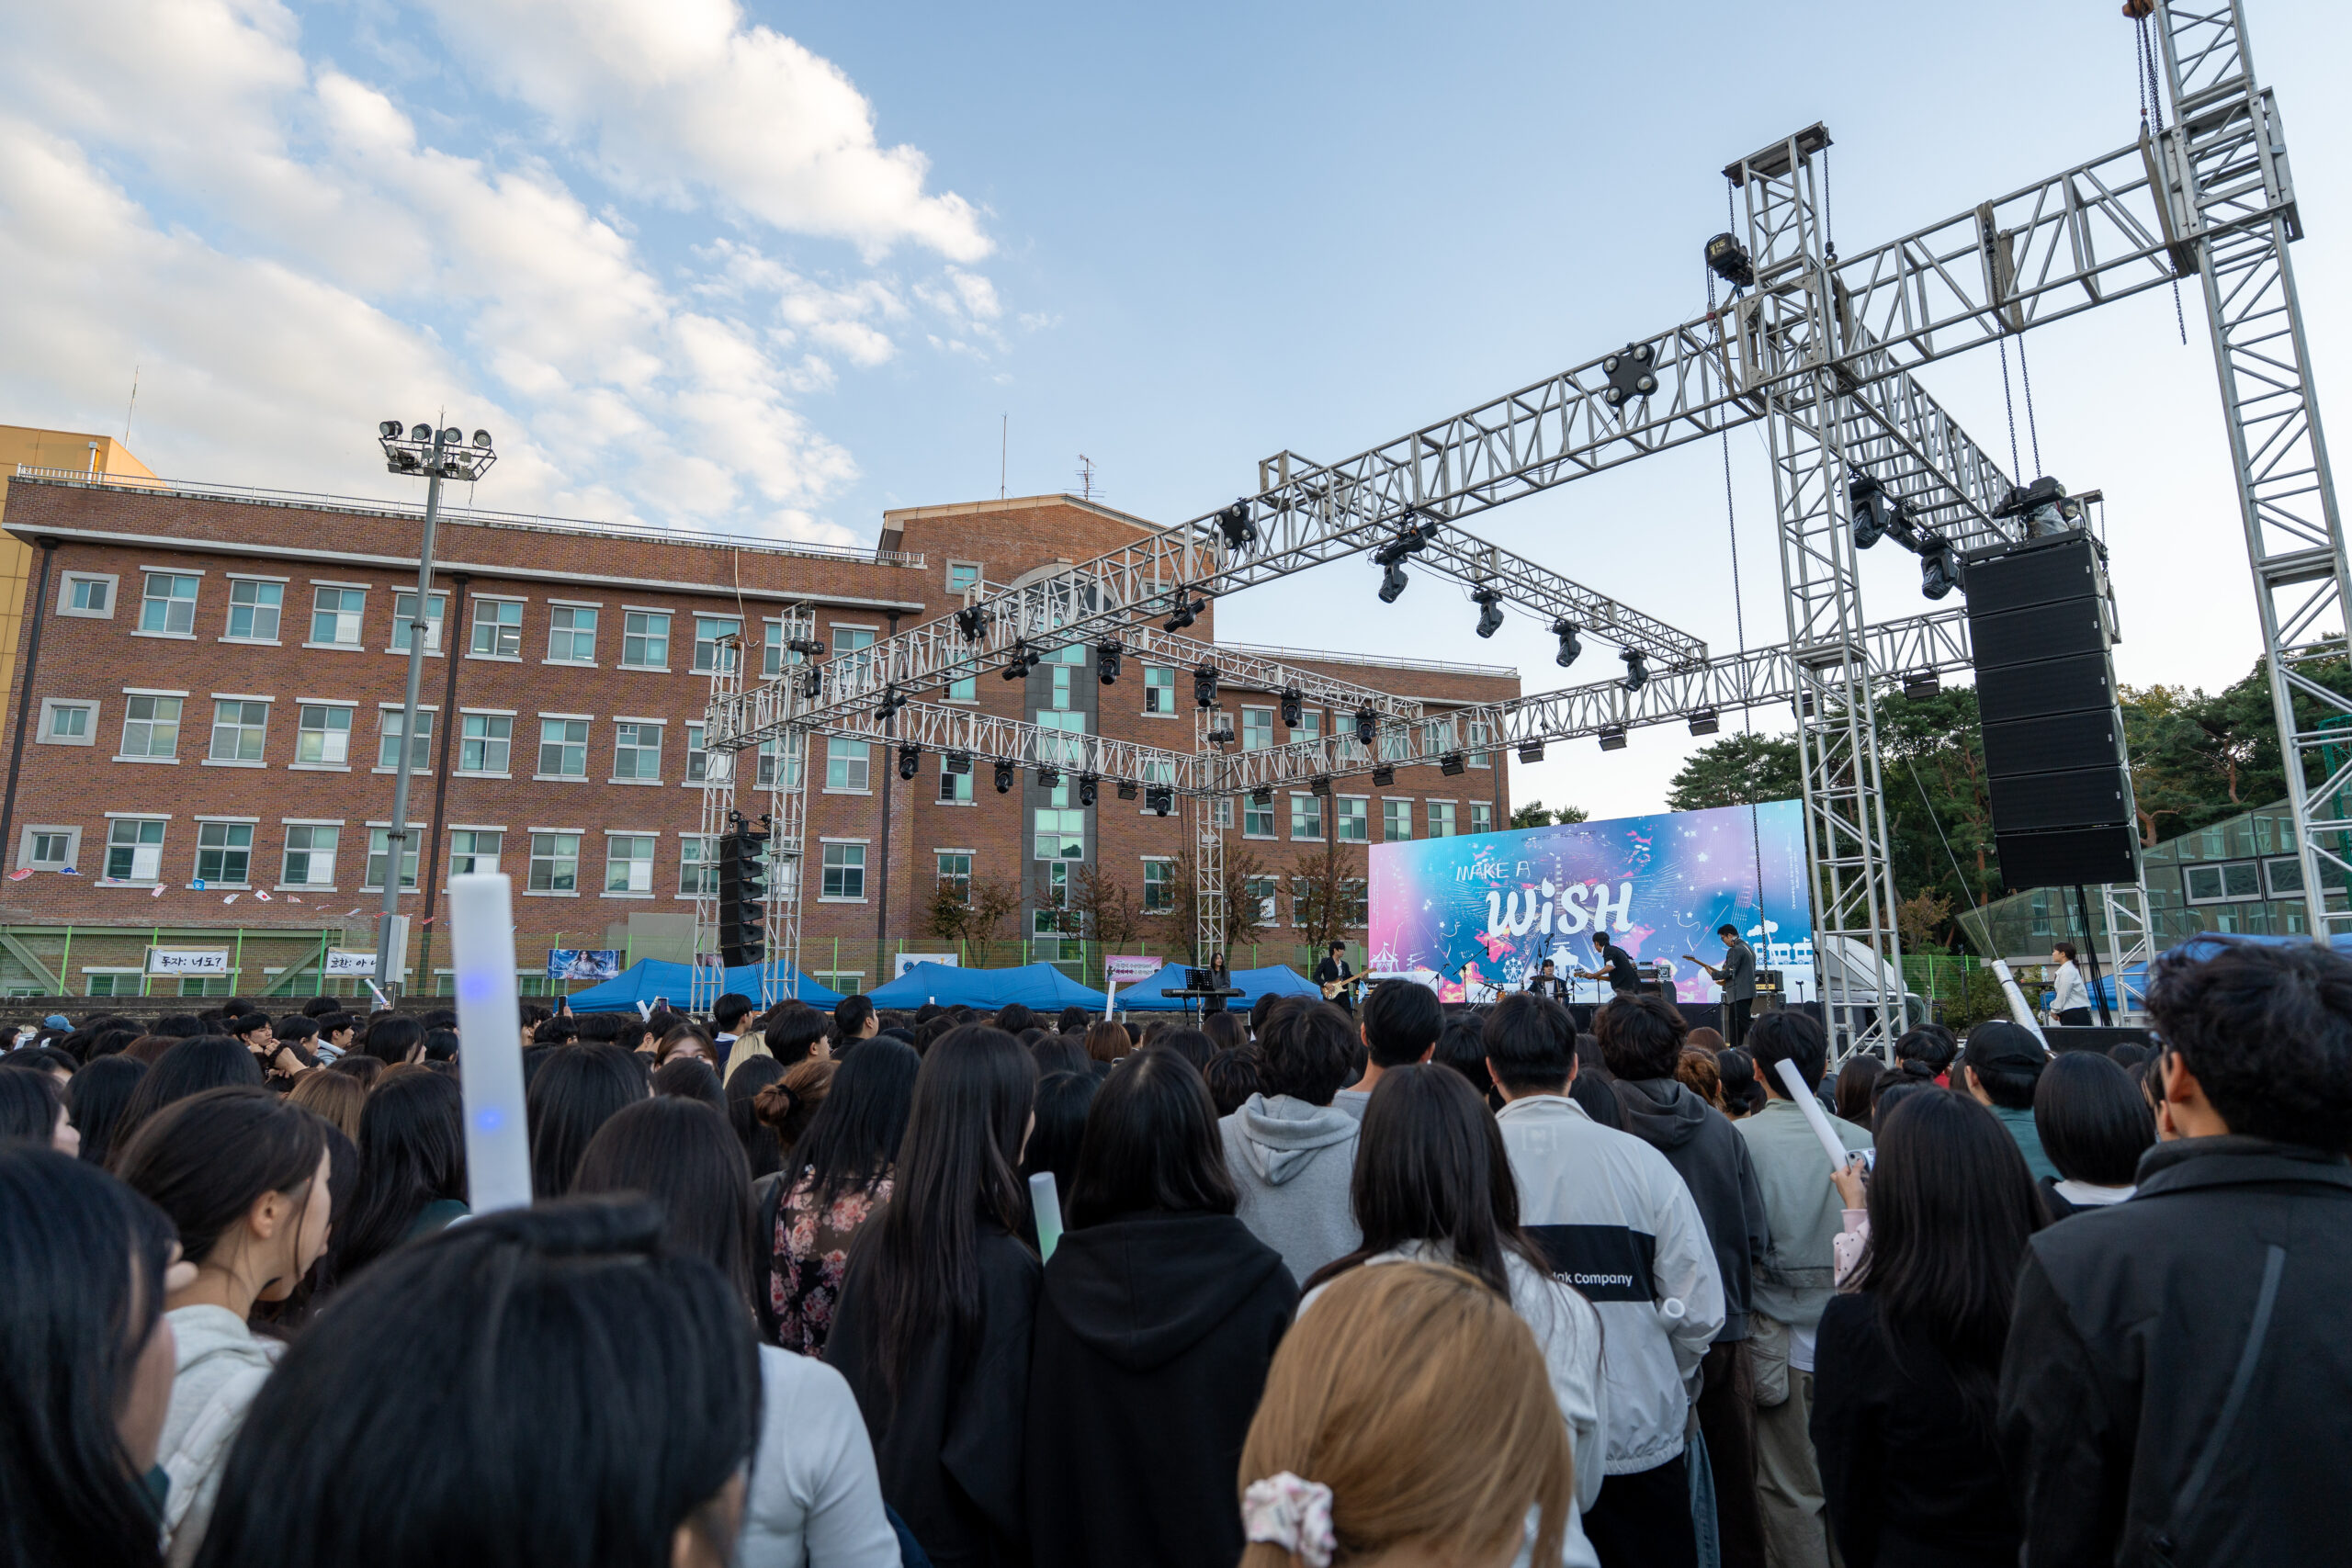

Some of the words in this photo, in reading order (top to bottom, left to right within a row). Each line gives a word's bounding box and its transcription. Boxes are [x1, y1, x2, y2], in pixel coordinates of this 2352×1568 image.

[1455, 863, 1510, 881] MAKE
[1516, 861, 1531, 877] A
[161, 956, 187, 967] 동자:
[191, 956, 222, 967] 너도?
[1574, 1272, 1633, 1288] Company
